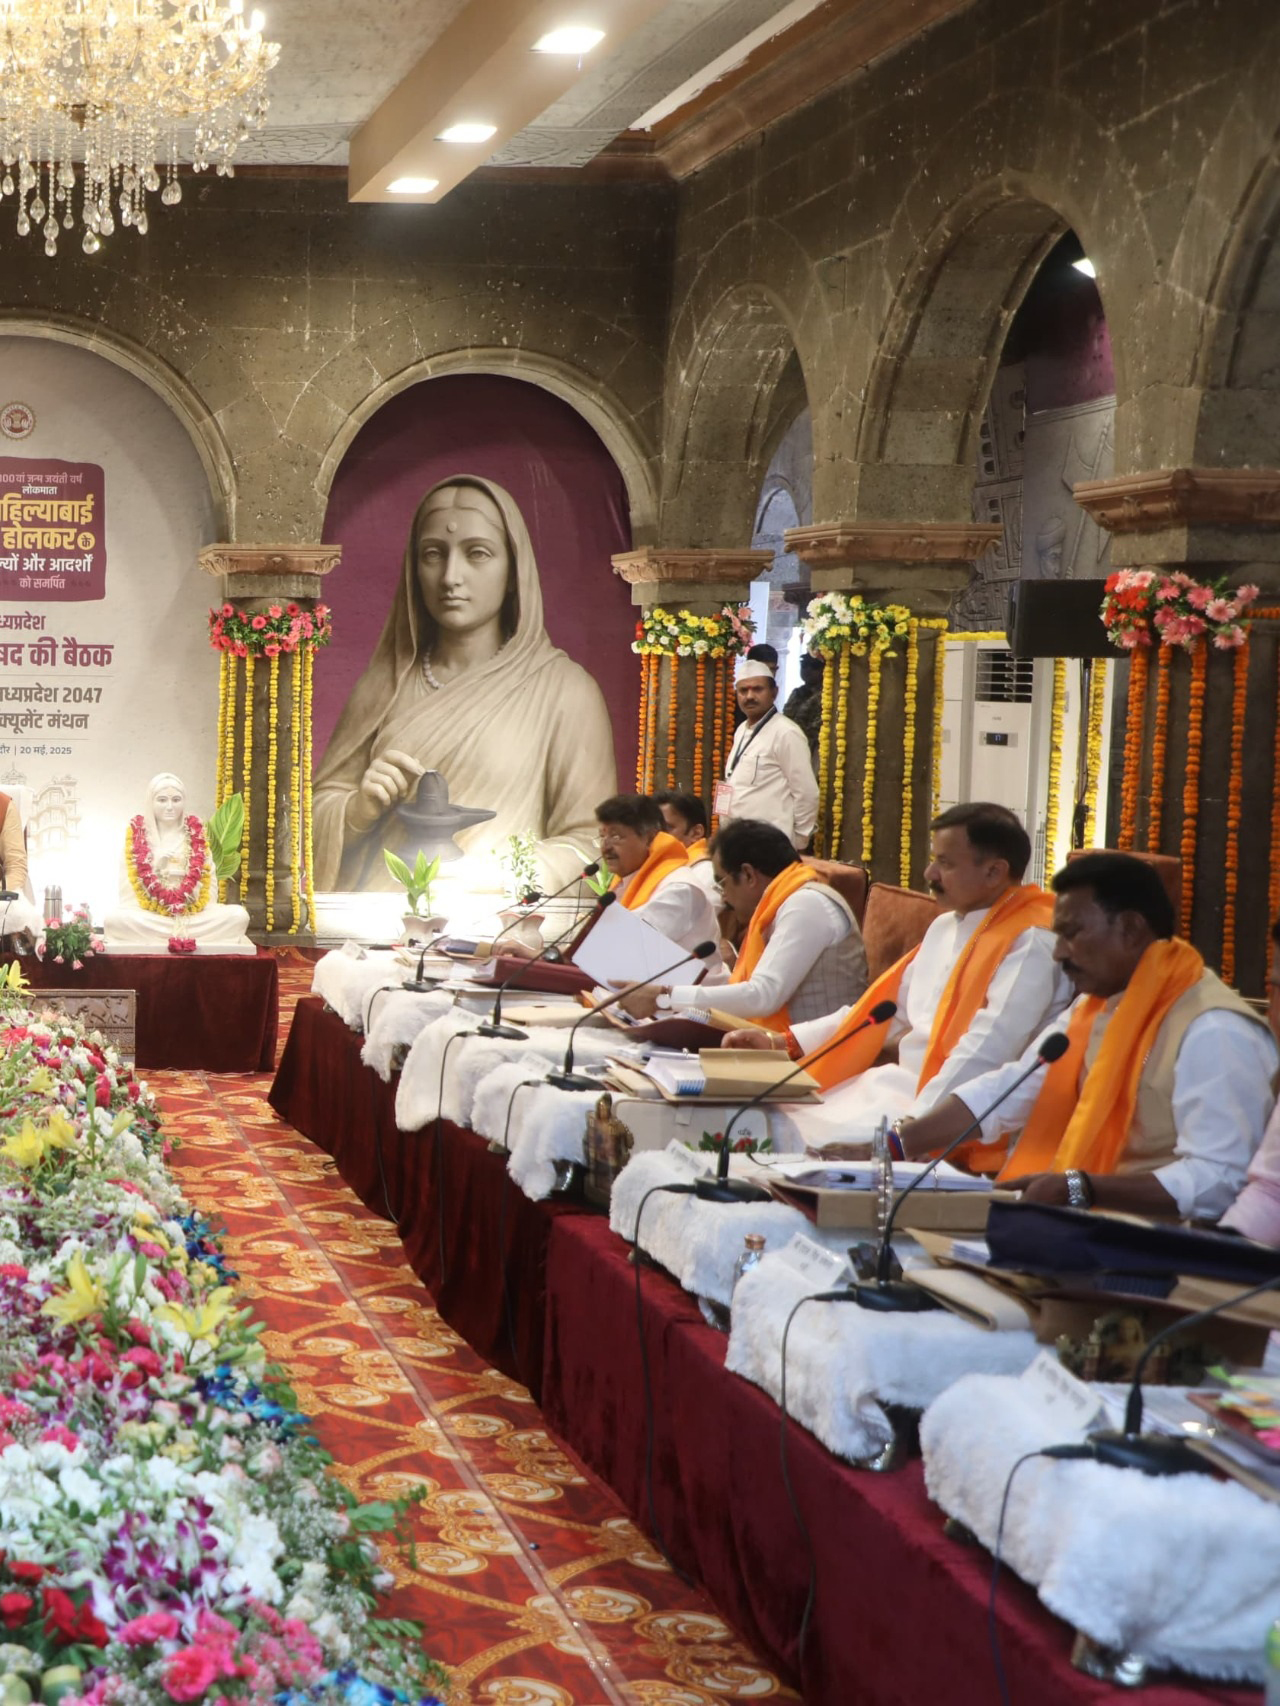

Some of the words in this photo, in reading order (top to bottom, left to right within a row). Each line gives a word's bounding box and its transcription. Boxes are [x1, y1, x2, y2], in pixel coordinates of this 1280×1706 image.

[26, 473, 43, 484] जन्म
[45, 472, 68, 484] जयंती
[69, 472, 83, 484] वर्ष
[21, 483, 58, 495] लोकमाता
[1, 520, 77, 550] होलकर
[79, 533, 94, 549] के
[22, 553, 46, 572] और
[49, 553, 94, 572] आदर्शों
[19, 575, 32, 589] को
[32, 575, 66, 589] समर्पित
[28, 636, 58, 667] की
[62, 637, 114, 667] बैठक
[62, 687, 103, 703] 2047
[47, 709, 90, 729] मंथन
[20, 746, 32, 755] 20
[50, 746, 72, 755] 2025
